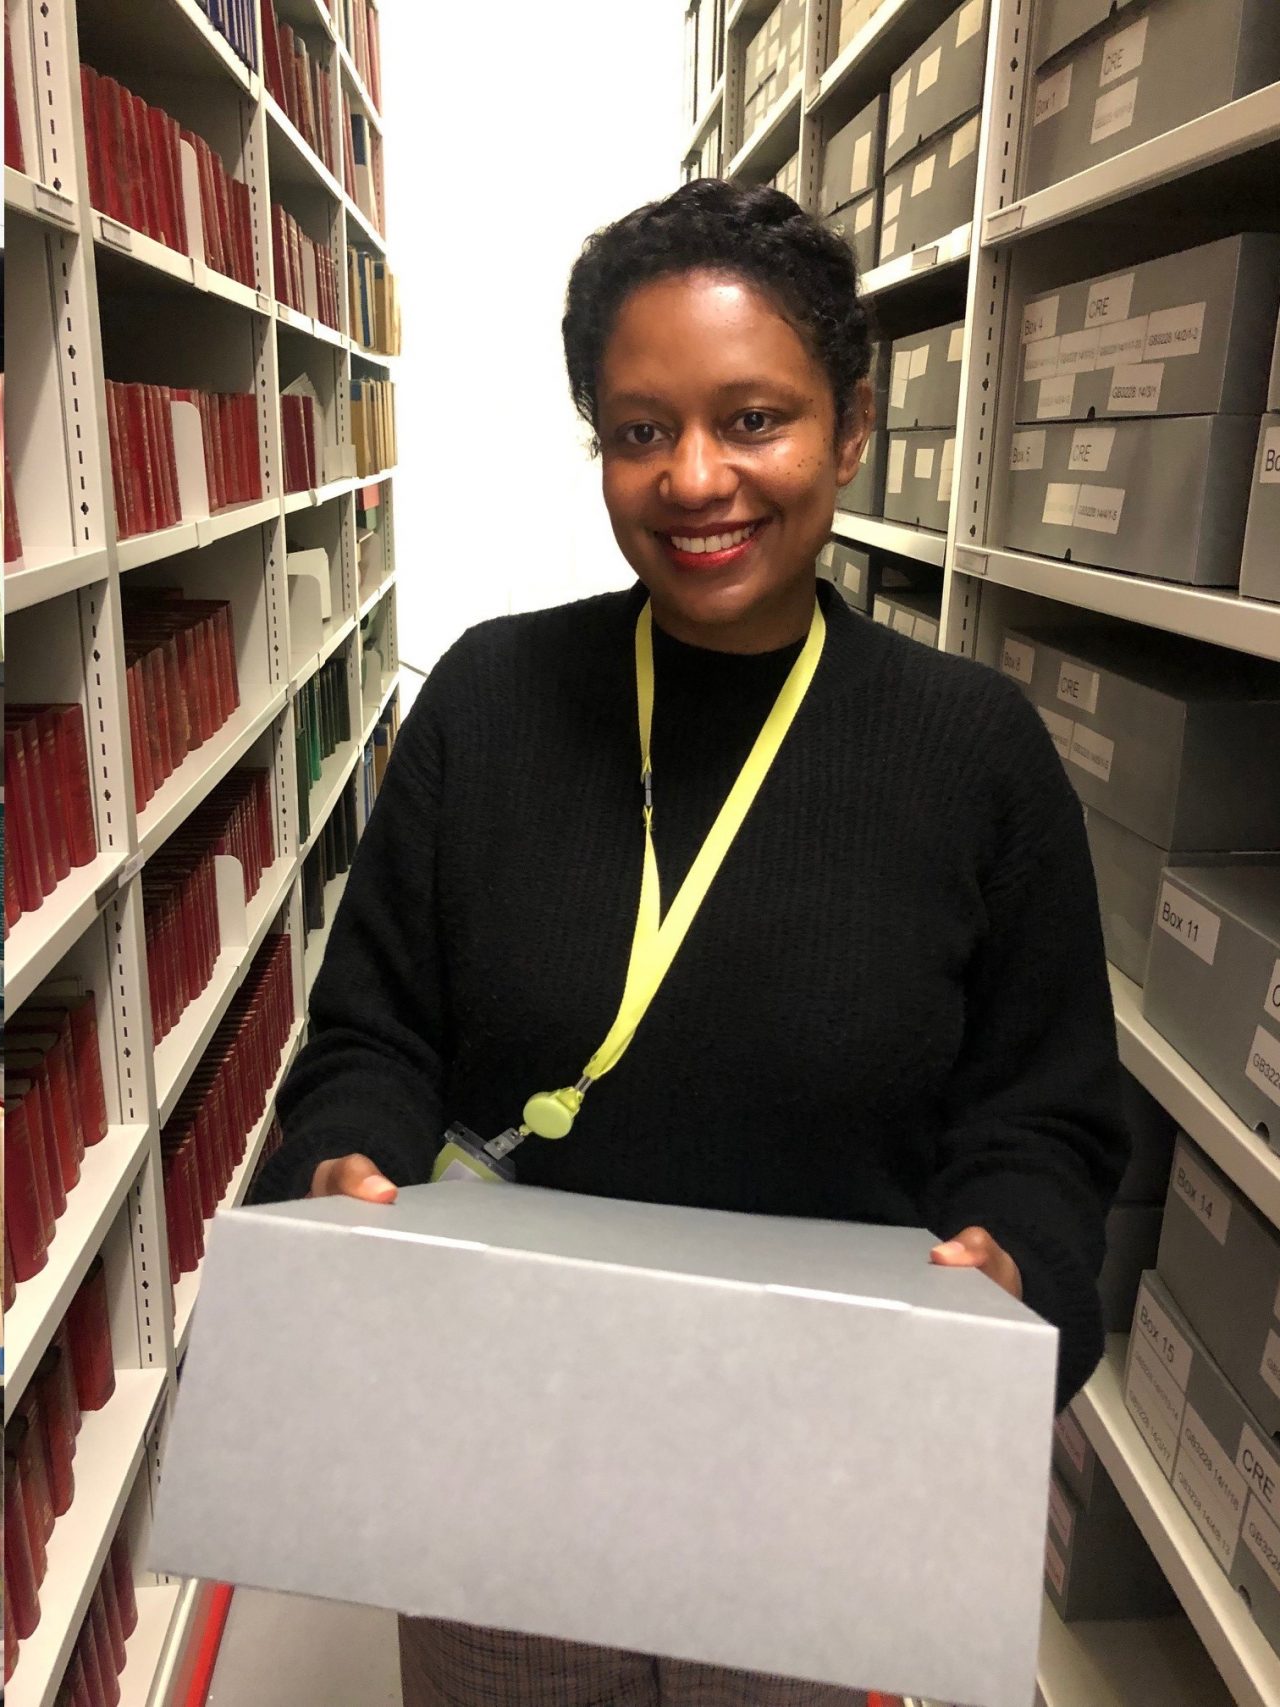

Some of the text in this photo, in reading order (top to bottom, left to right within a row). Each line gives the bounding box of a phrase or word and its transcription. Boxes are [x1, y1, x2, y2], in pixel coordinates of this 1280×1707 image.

[1103, 48, 1124, 76] CRE
[1089, 297, 1109, 319] CRE
[1073, 444, 1092, 463] CRE
[1061, 677, 1080, 699] CRE
[1161, 903, 1200, 942] Box 11
[1177, 1168, 1213, 1220] Box 14
[1140, 1304, 1175, 1364] Box 15
[1241, 1448, 1275, 1504] CRE
